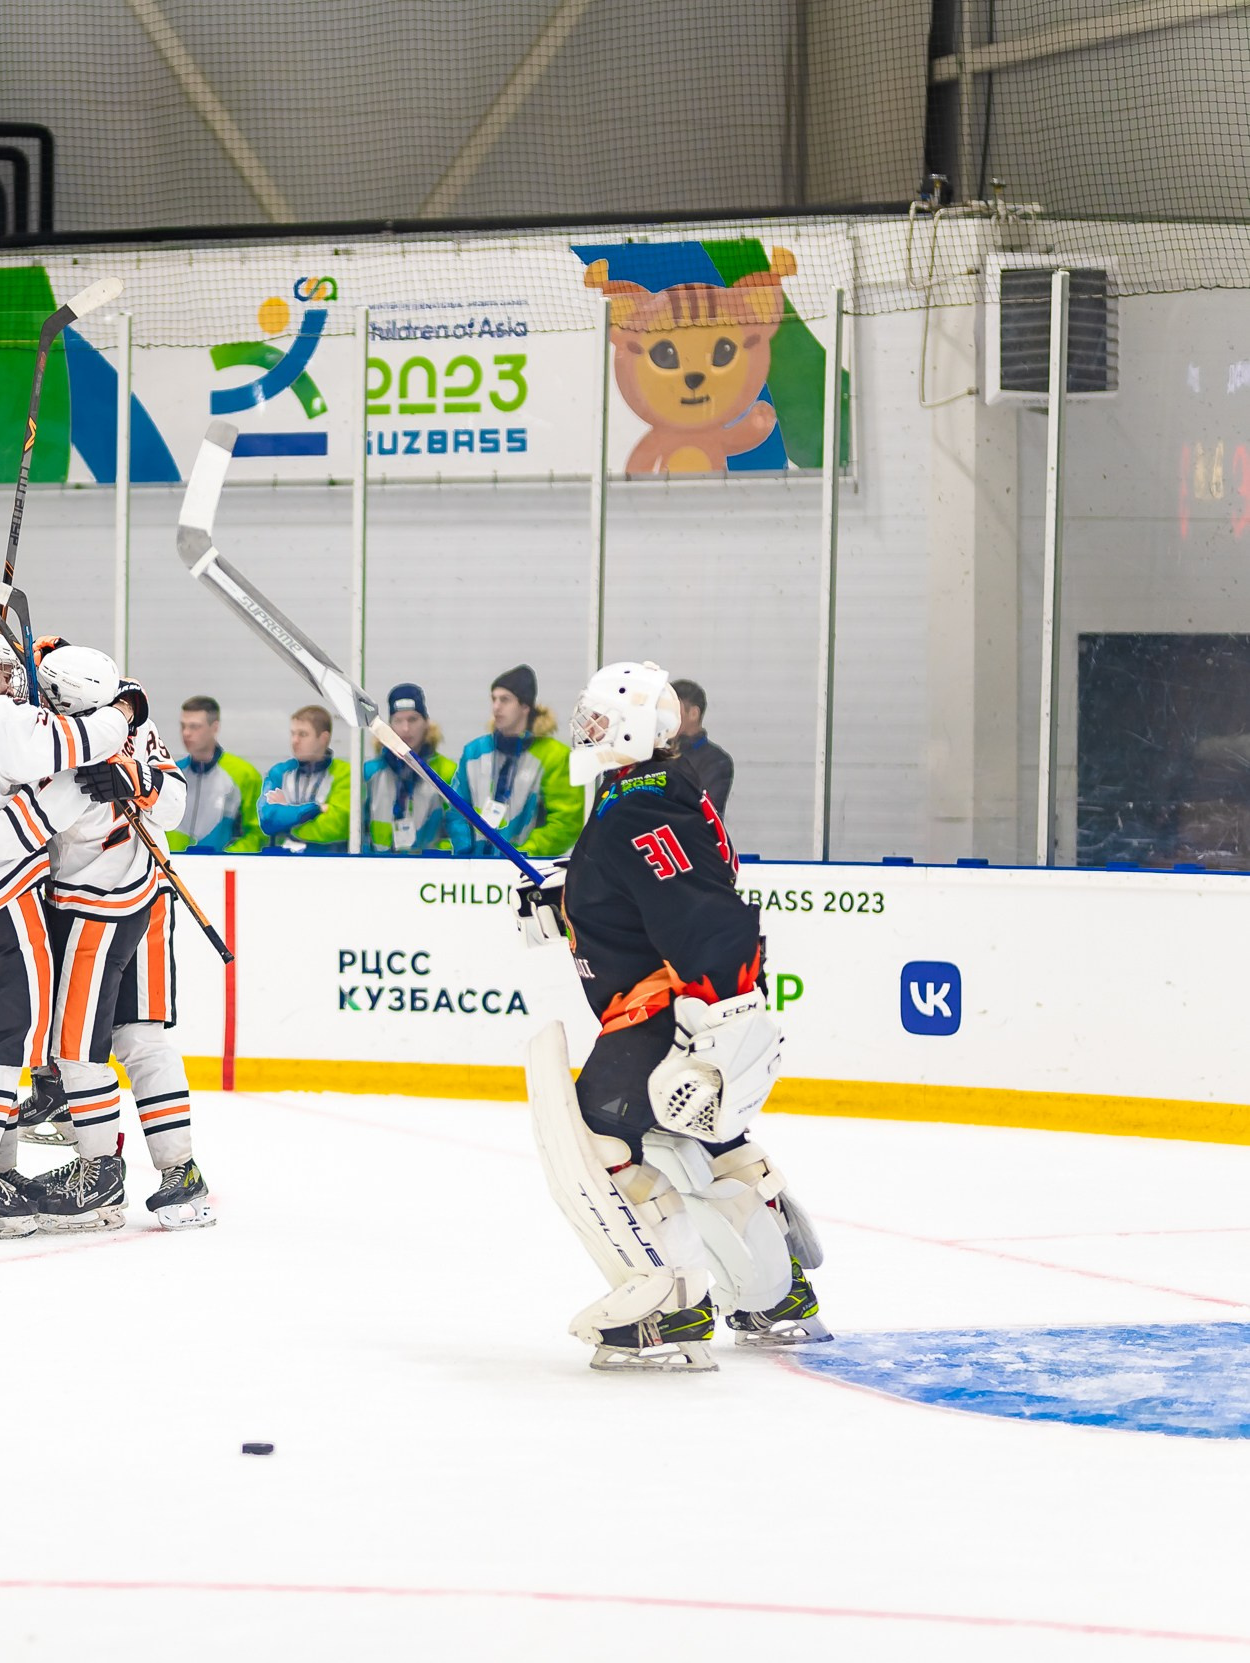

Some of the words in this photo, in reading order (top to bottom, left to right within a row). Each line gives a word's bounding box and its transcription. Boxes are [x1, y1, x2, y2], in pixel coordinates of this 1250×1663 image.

[368, 318, 449, 341] hildren
[367, 353, 528, 415] 2023
[631, 824, 694, 881] 31
[419, 883, 512, 905] CHILD
[736, 888, 814, 912] BASS
[823, 890, 885, 914] 2023
[338, 949, 431, 979] РЦСС
[338, 985, 529, 1015] КУЗБАССА
[722, 1001, 758, 1019] CCM
[909, 981, 952, 1018] VK
[578, 1181, 635, 1268] TRUE
[607, 1180, 665, 1268] TRUE
